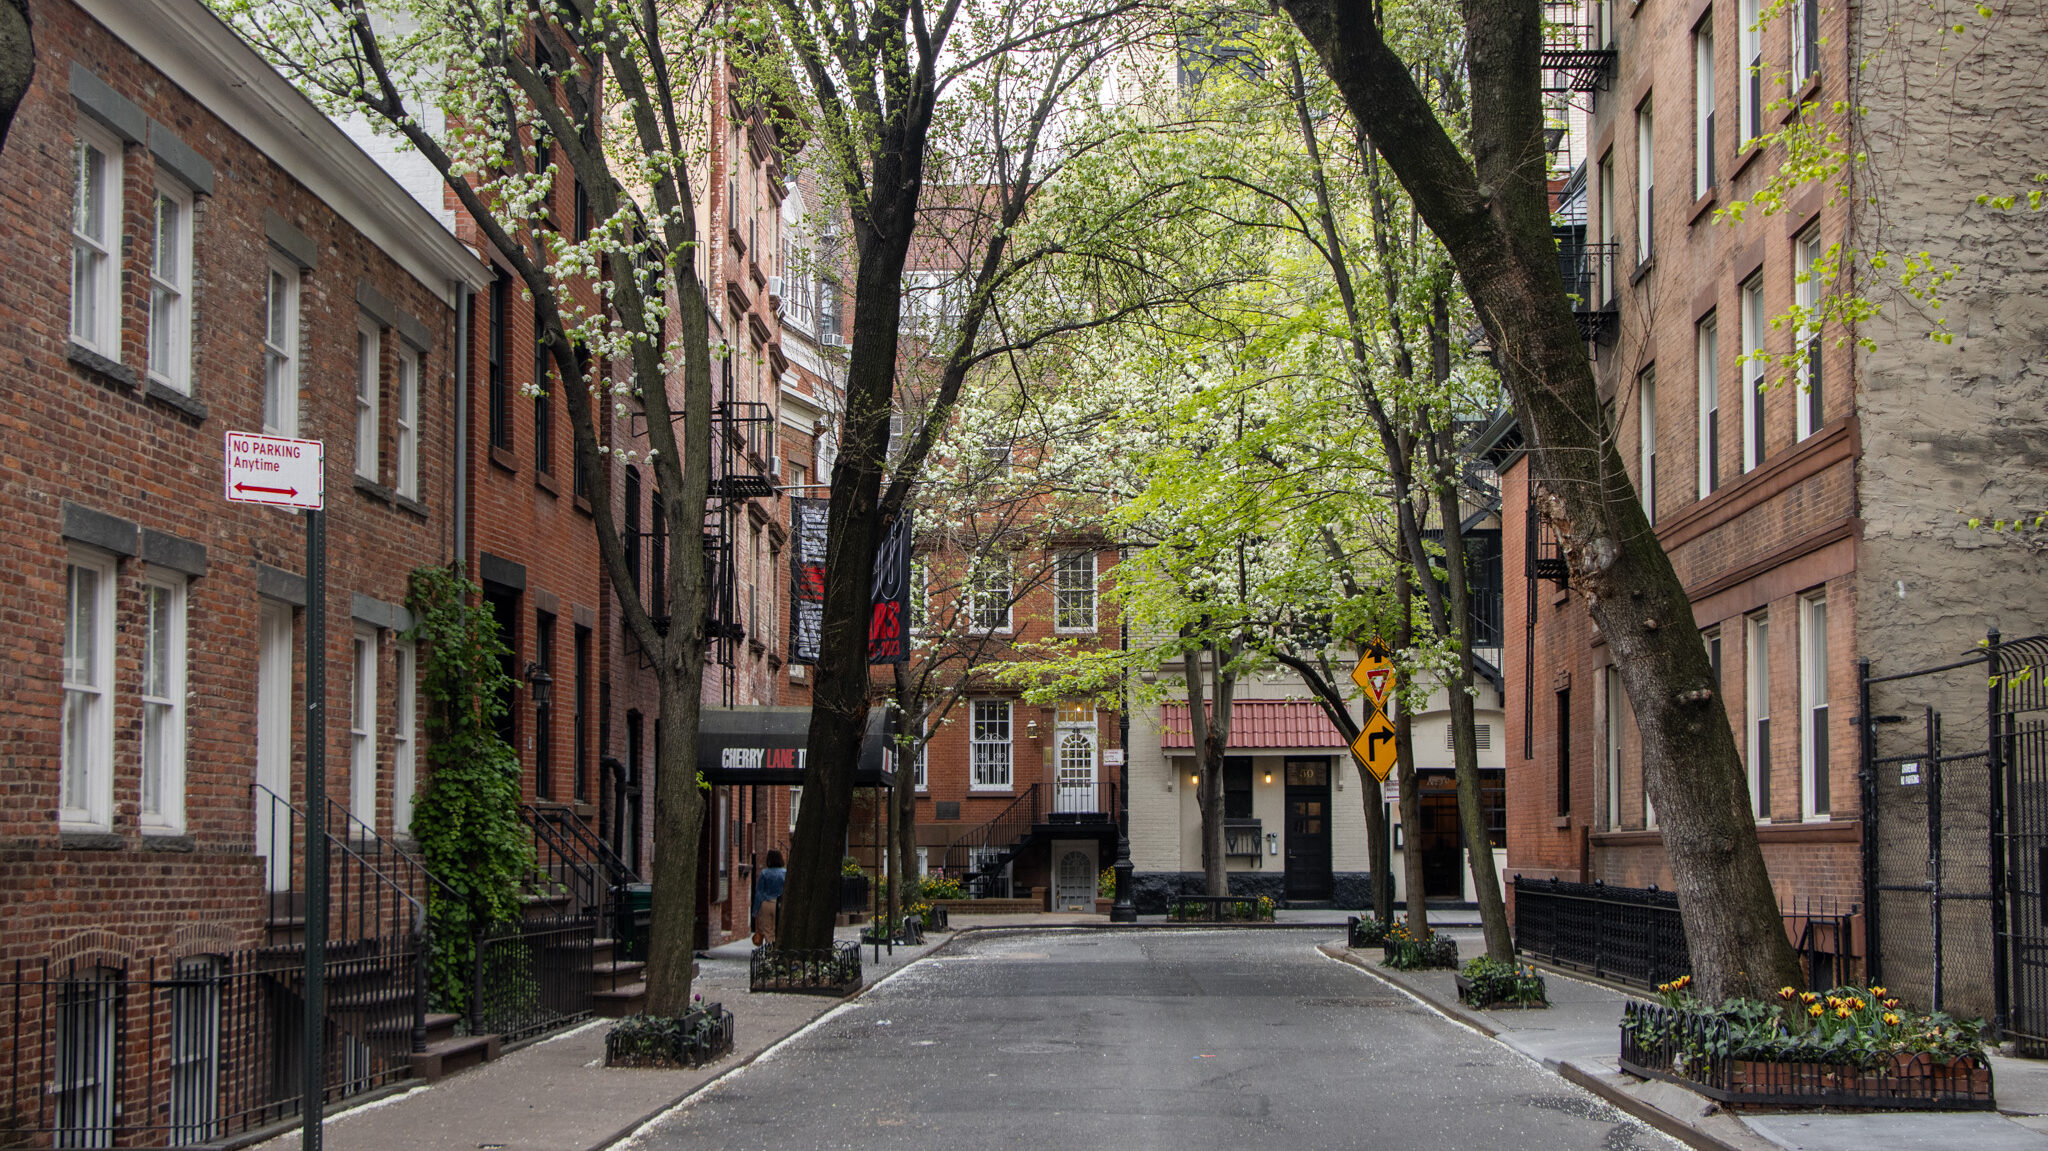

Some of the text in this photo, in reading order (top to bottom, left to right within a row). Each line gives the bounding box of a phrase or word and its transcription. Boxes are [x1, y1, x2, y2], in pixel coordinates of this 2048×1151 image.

[233, 440, 301, 459] NO PARKING
[233, 456, 280, 472] Anytime
[721, 747, 765, 769] CHERRY
[766, 748, 796, 769] LANE
